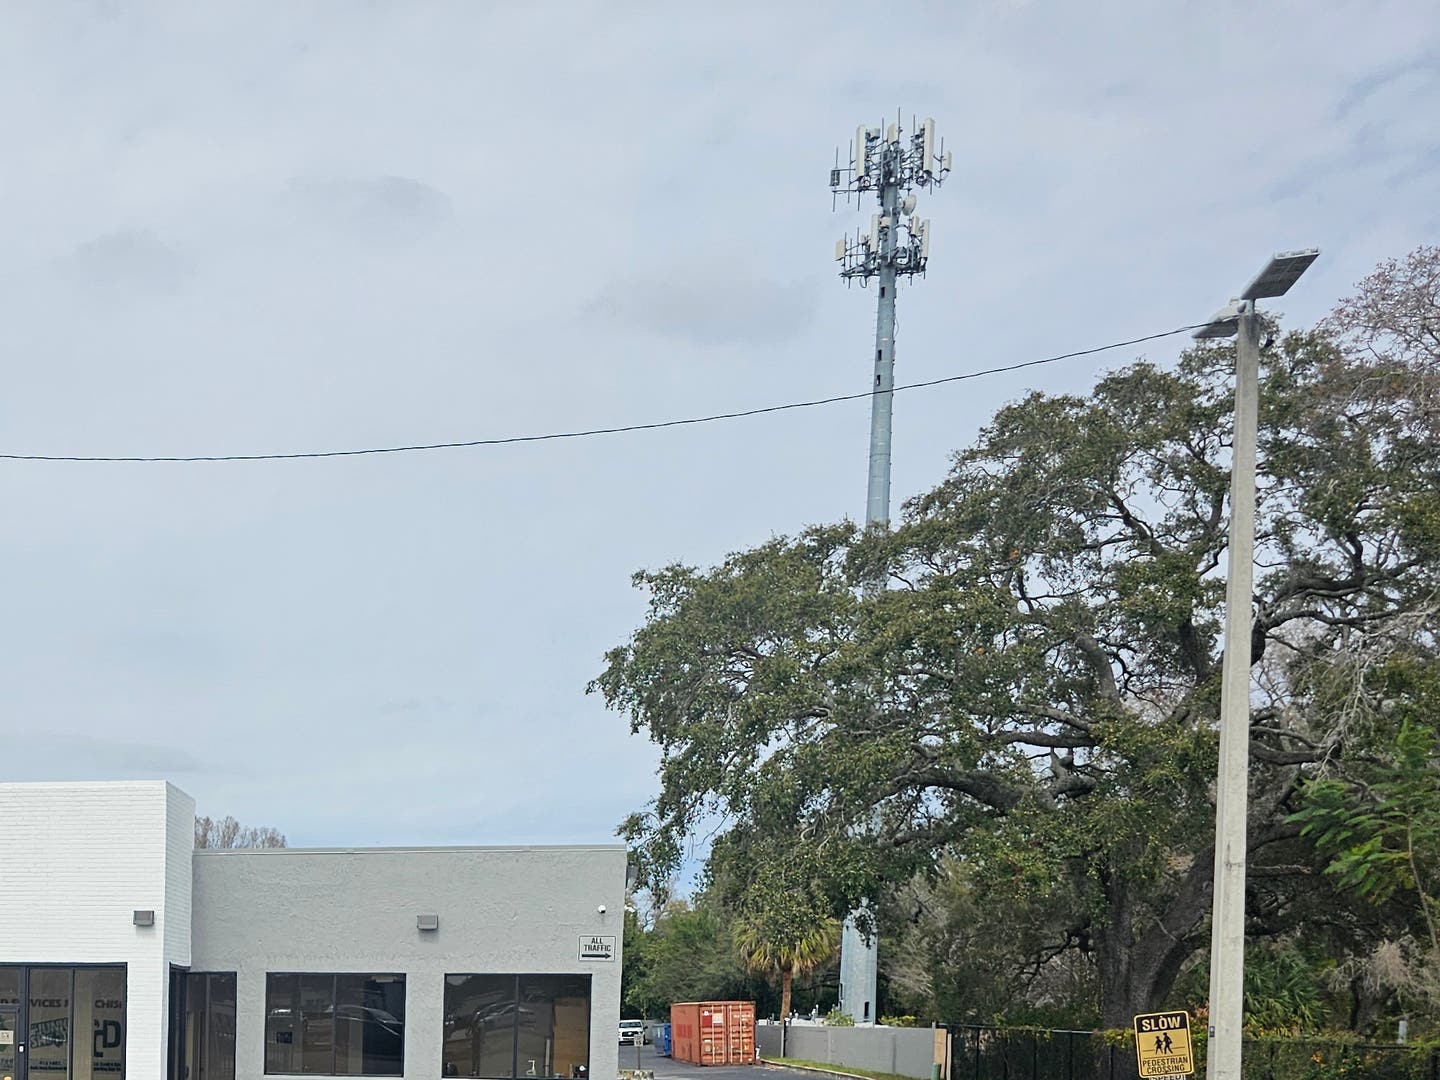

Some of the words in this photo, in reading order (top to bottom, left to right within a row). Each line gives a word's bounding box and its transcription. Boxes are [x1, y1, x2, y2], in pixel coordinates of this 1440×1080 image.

[1141, 1016, 1180, 1031] SLOW
[1142, 1056, 1188, 1067] PEDESTRIAN
[1147, 1064, 1185, 1074] CROSSING
